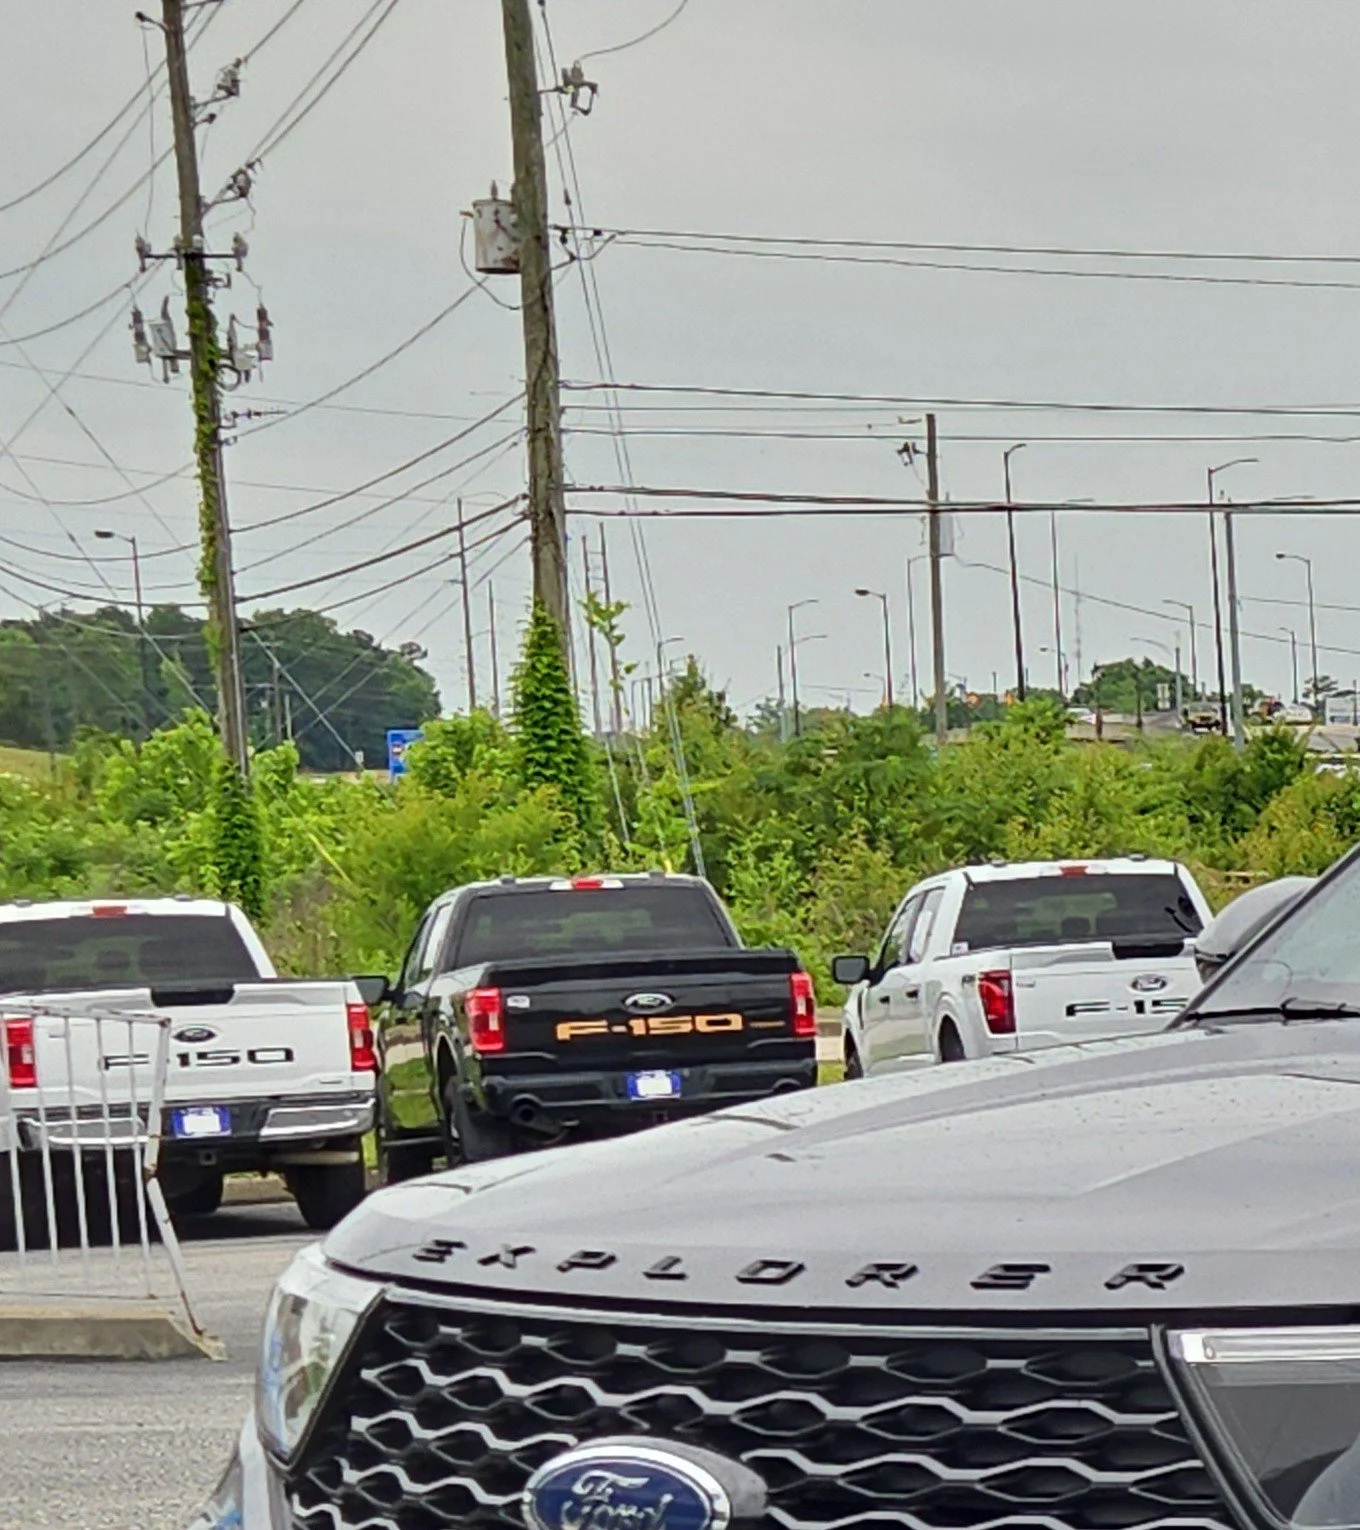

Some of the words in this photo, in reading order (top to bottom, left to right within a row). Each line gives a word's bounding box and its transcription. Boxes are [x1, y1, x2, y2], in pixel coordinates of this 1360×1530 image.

[1065, 997, 1190, 1017] F-15
[555, 1012, 744, 1042] F-150
[411, 1239, 1187, 1291] EXPLORER
